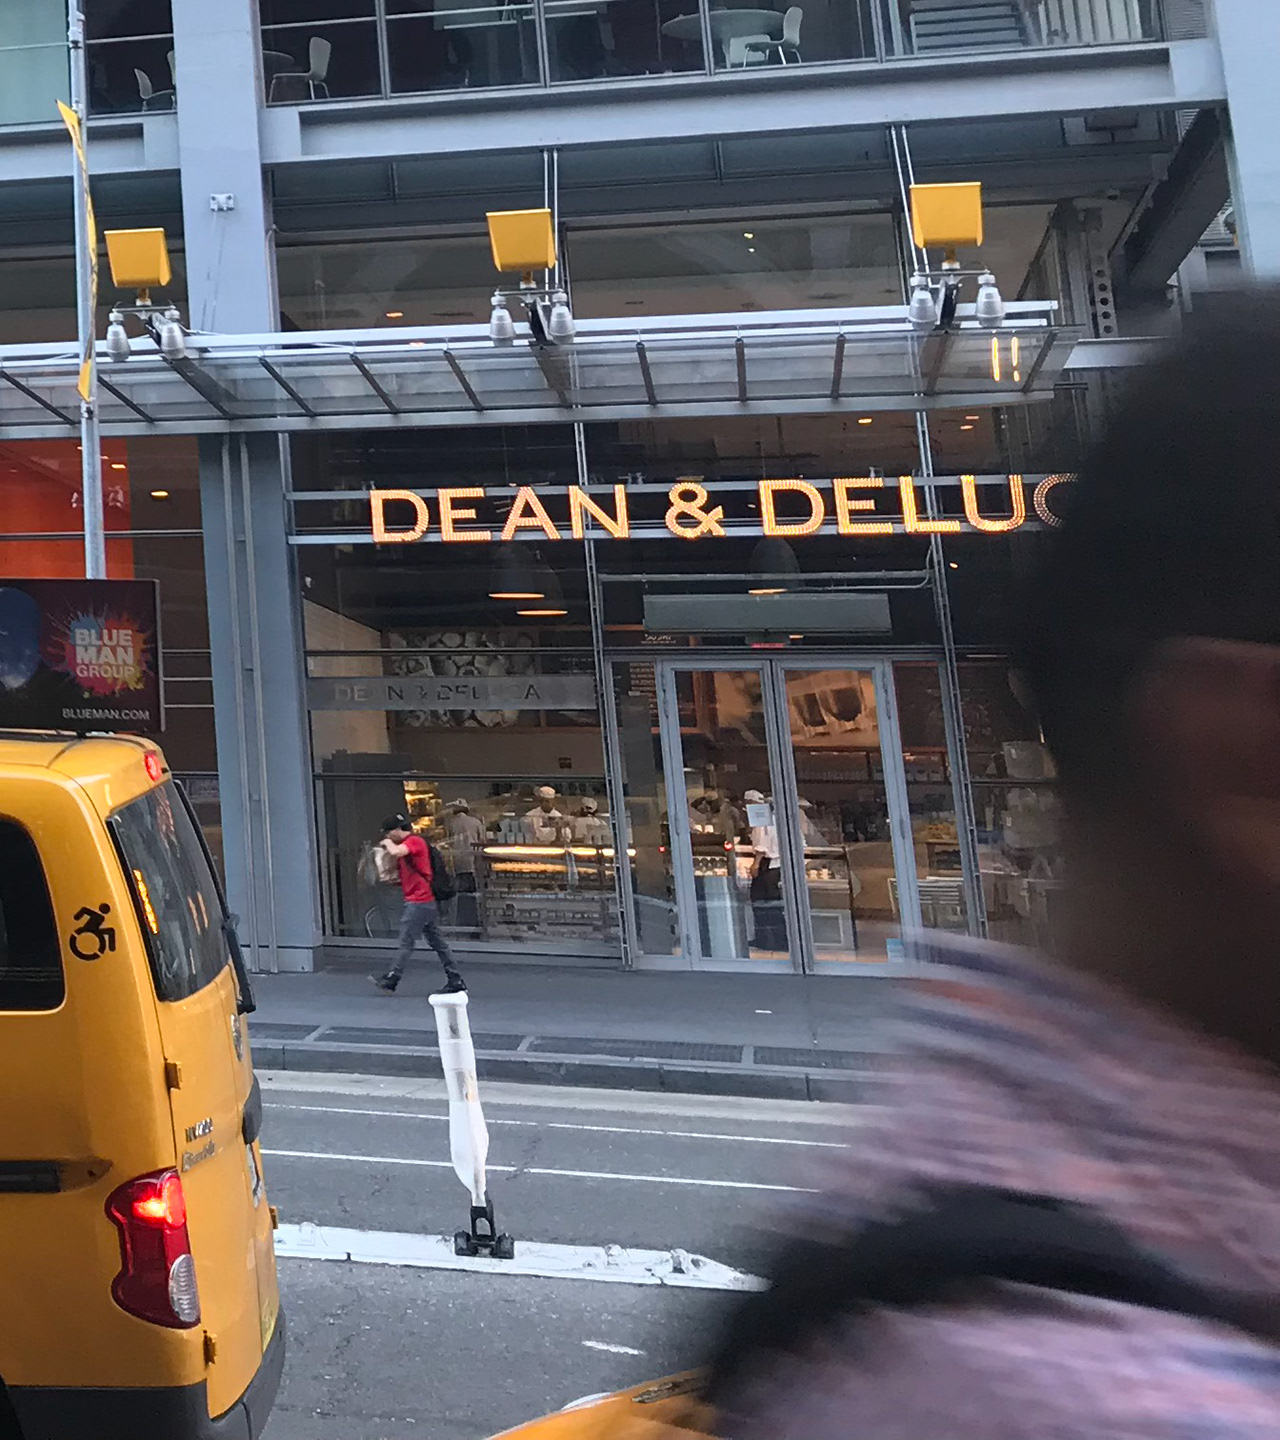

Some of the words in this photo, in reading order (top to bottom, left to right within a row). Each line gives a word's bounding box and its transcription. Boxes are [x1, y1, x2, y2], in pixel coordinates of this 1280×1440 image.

[369, 483, 629, 543] DEAN
[665, 481, 728, 540] &
[75, 628, 133, 646] BLUE
[76, 646, 134, 665] MAN
[76, 665, 135, 679] GROUP
[62, 707, 151, 720] BLUEMAN.COM
